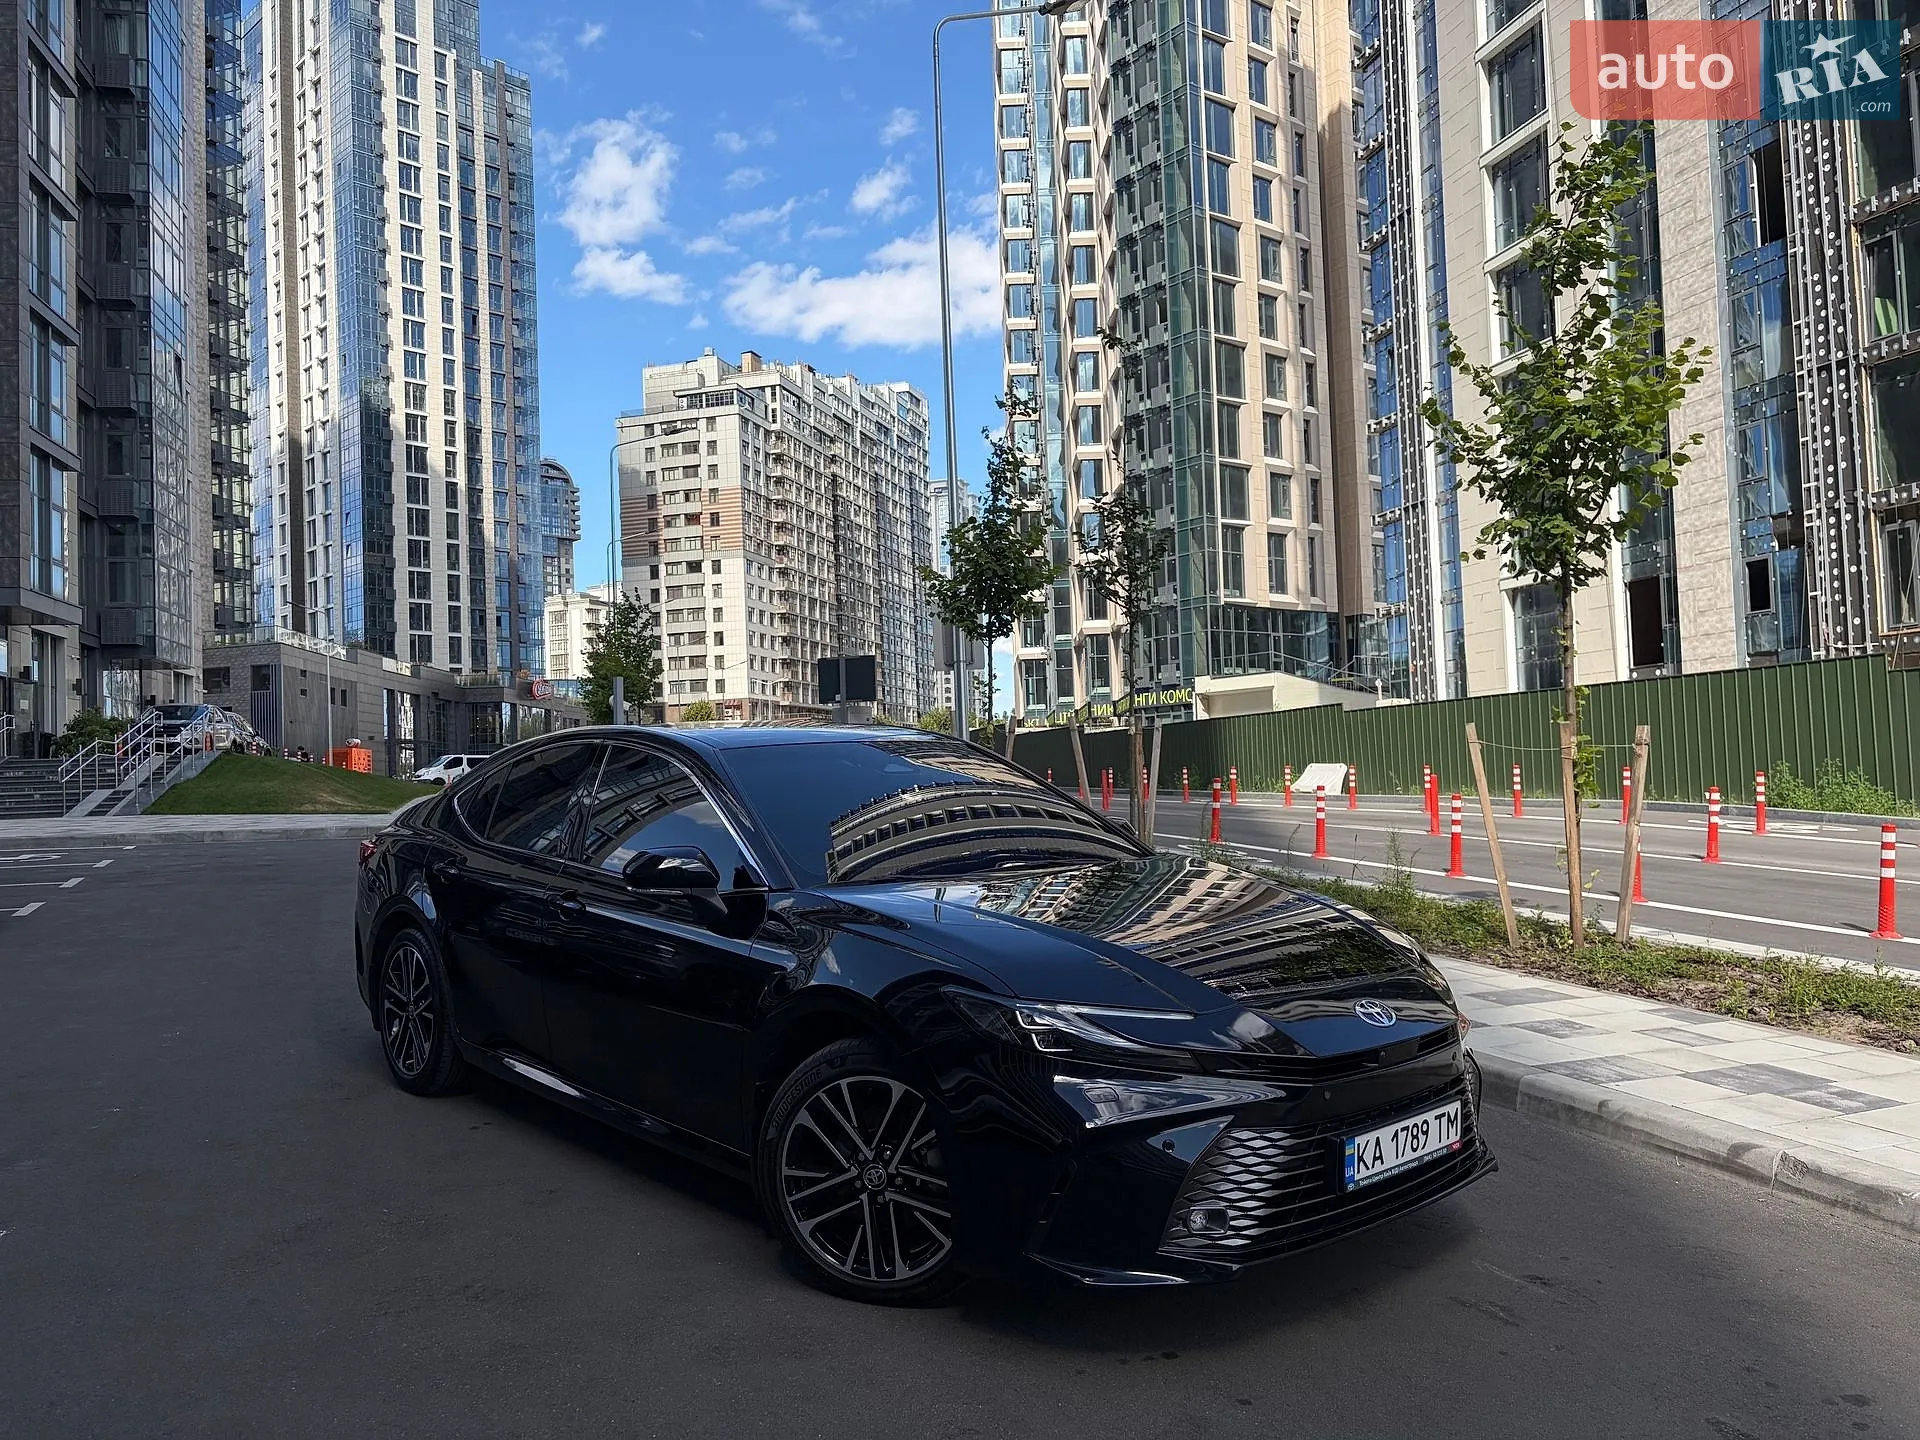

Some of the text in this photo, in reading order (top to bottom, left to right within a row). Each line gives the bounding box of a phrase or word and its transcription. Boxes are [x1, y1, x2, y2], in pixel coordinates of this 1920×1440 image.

[772, 1069, 823, 1129] BRIDGESTONE
[1357, 1107, 1459, 1174] KA 1789 TM
[1345, 1166, 1354, 1177] UA
